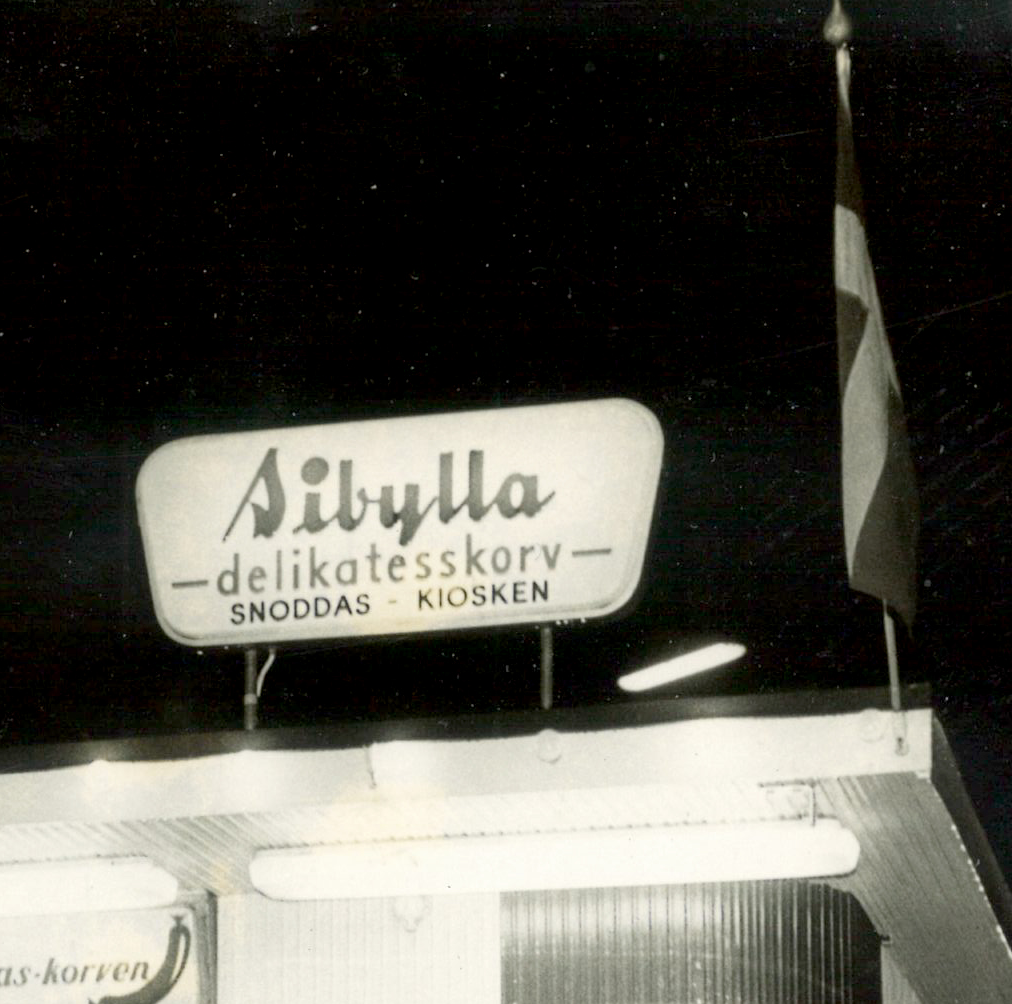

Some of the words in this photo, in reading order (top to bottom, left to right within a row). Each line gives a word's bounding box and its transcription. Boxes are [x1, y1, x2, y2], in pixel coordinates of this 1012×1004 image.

[223, 448, 555, 545] Sibylla
[216, 535, 563, 595] delikatesskorv
[230, 593, 371, 625] SNODDAS
[417, 579, 550, 612] KIOSKEN
